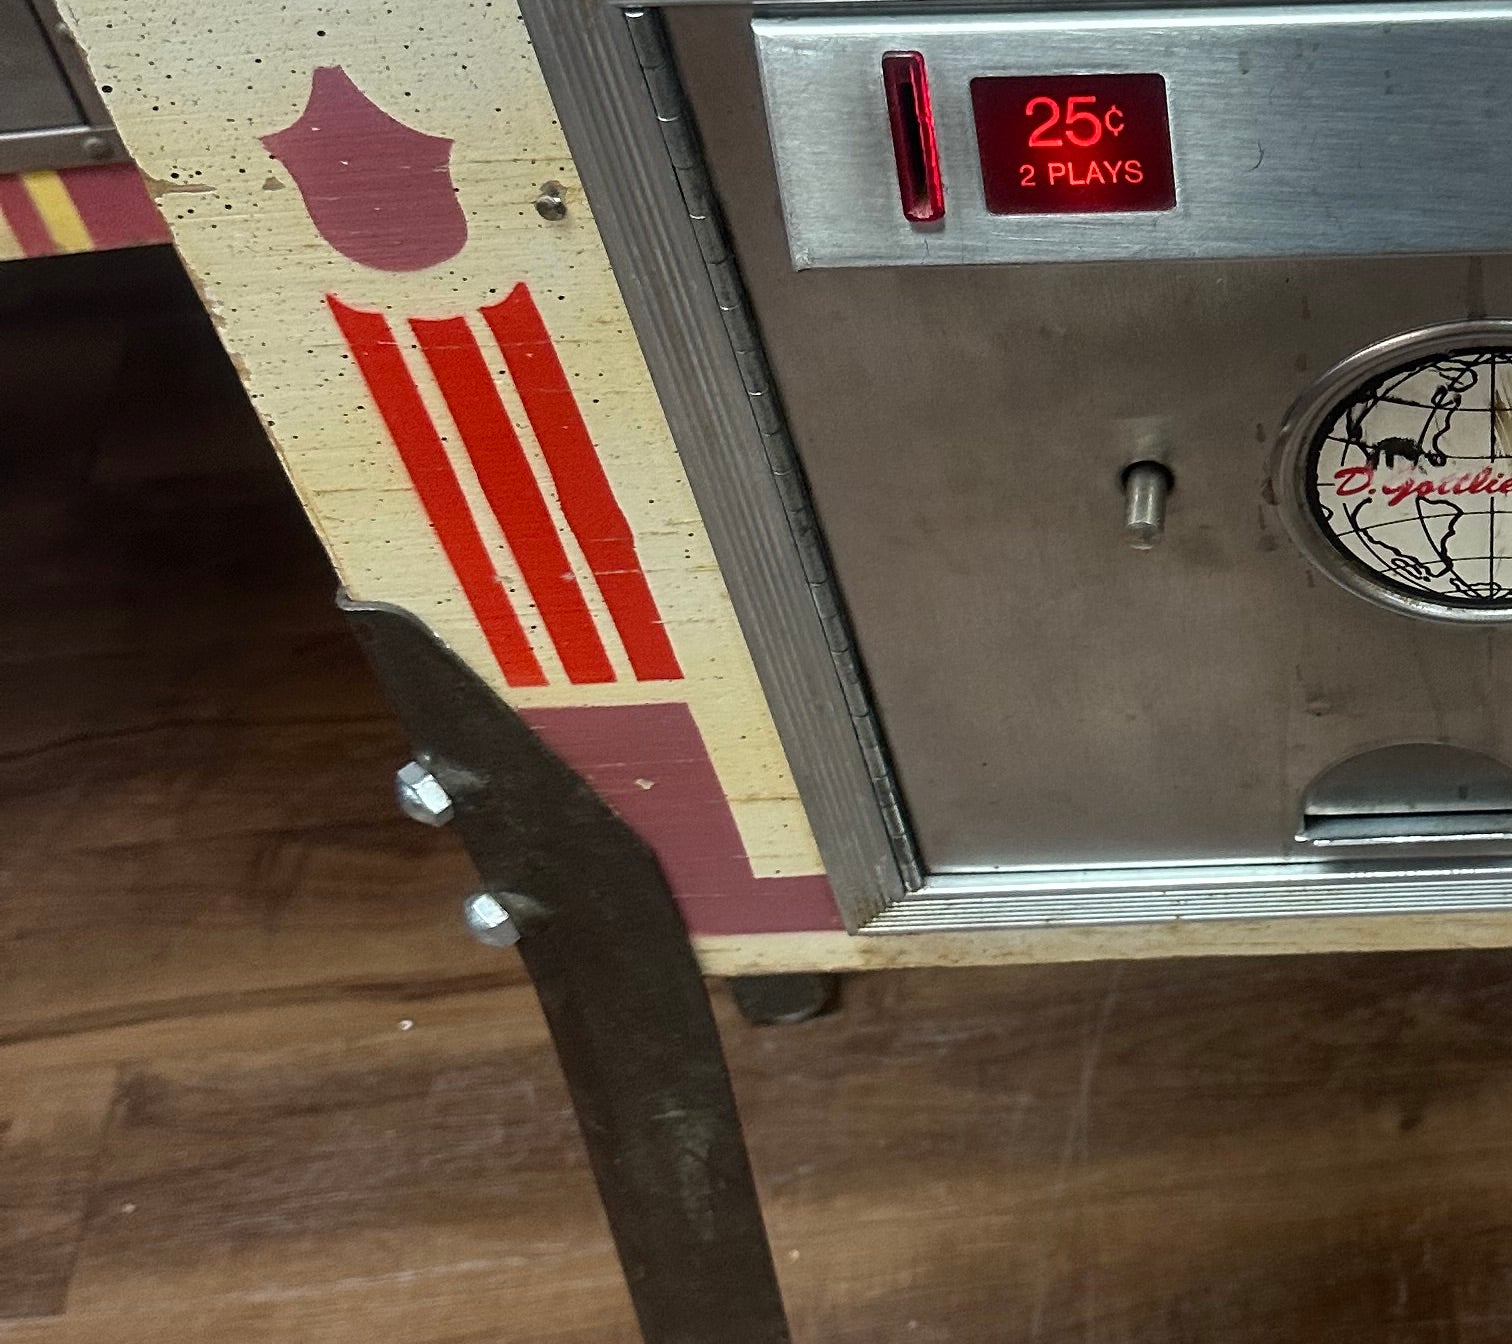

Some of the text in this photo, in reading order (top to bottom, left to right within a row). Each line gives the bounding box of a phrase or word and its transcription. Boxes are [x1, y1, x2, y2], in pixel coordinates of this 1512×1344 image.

[1024, 95, 1125, 148] 25¢
[1018, 159, 1144, 187] 2 PLAYS
